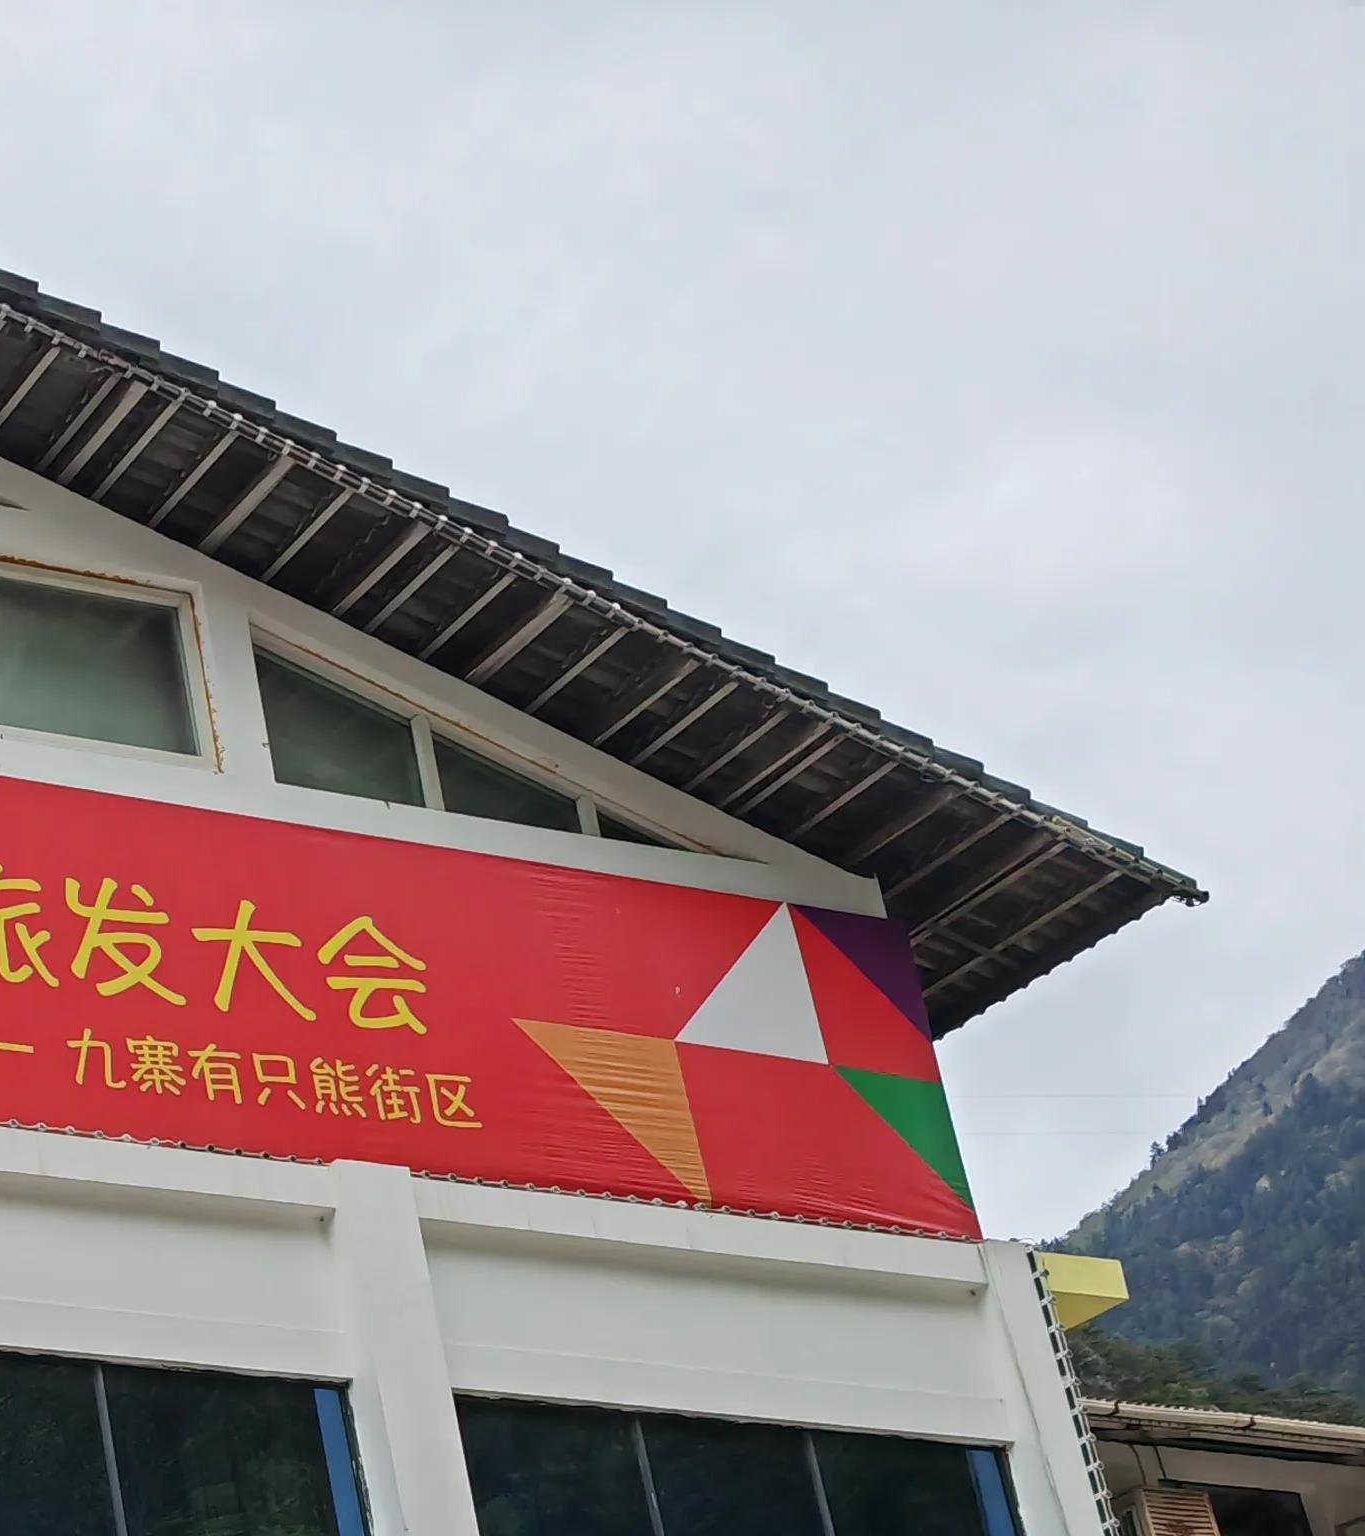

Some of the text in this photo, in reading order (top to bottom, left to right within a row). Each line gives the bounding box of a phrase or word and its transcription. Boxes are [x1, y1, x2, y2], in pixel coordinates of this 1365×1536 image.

[67, 1027, 482, 1128] 九寨有只熊街区
